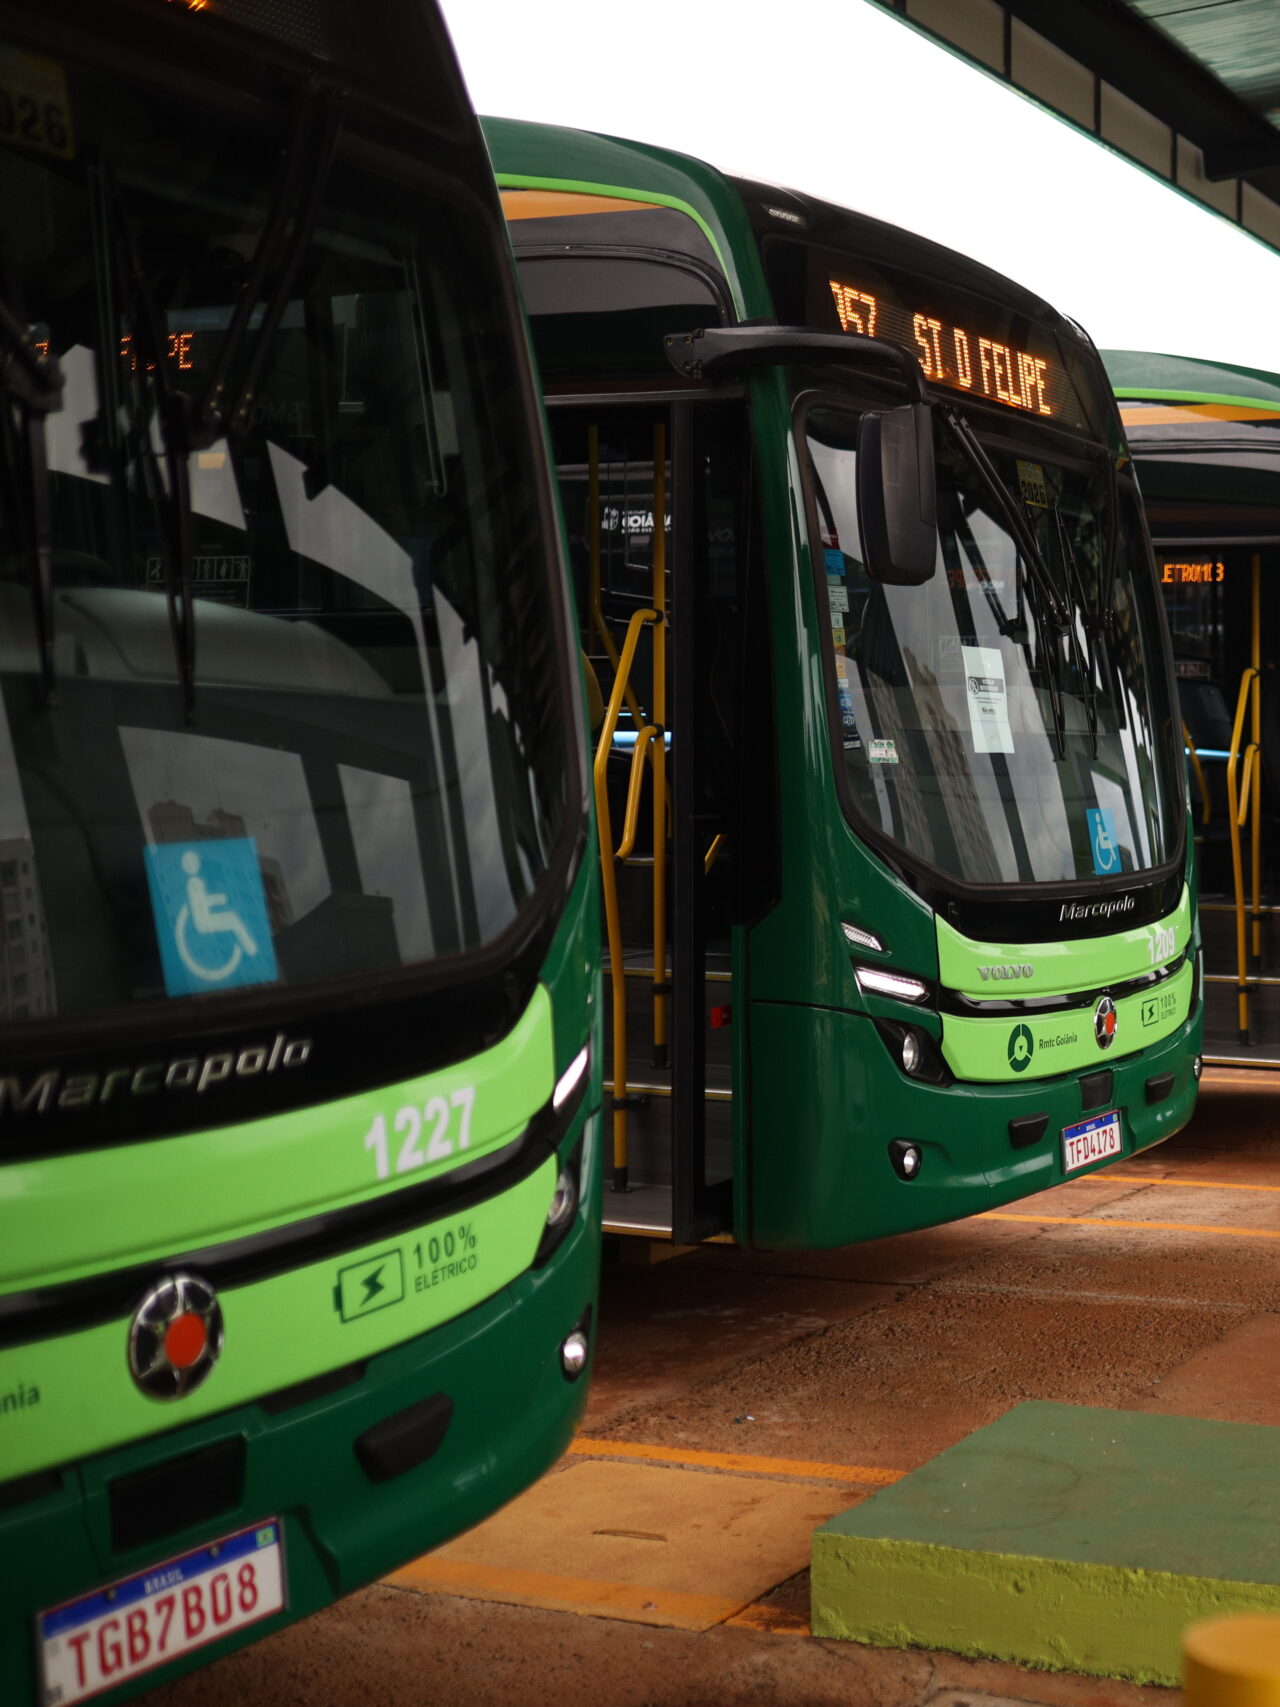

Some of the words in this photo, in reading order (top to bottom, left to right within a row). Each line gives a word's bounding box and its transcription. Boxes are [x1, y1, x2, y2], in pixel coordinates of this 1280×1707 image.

[912, 312, 945, 379] ST
[978, 336, 1053, 416] FELIPE
[1059, 894, 1136, 922] Marcopolo
[1148, 928, 1176, 965] 1209
[976, 963, 1034, 981] VOLVO
[1160, 991, 1177, 1010] 100%
[1056, 1032, 1078, 1048] Goiânia
[0, 1032, 314, 1117] Marcopolo
[363, 1085, 476, 1181] 1227
[412, 1222, 477, 1270] 100%
[414, 1253, 478, 1294] ELÉTRICO
[142, 1567, 185, 1595] BRASIL
[66, 1561, 260, 1690] TGB7B08
